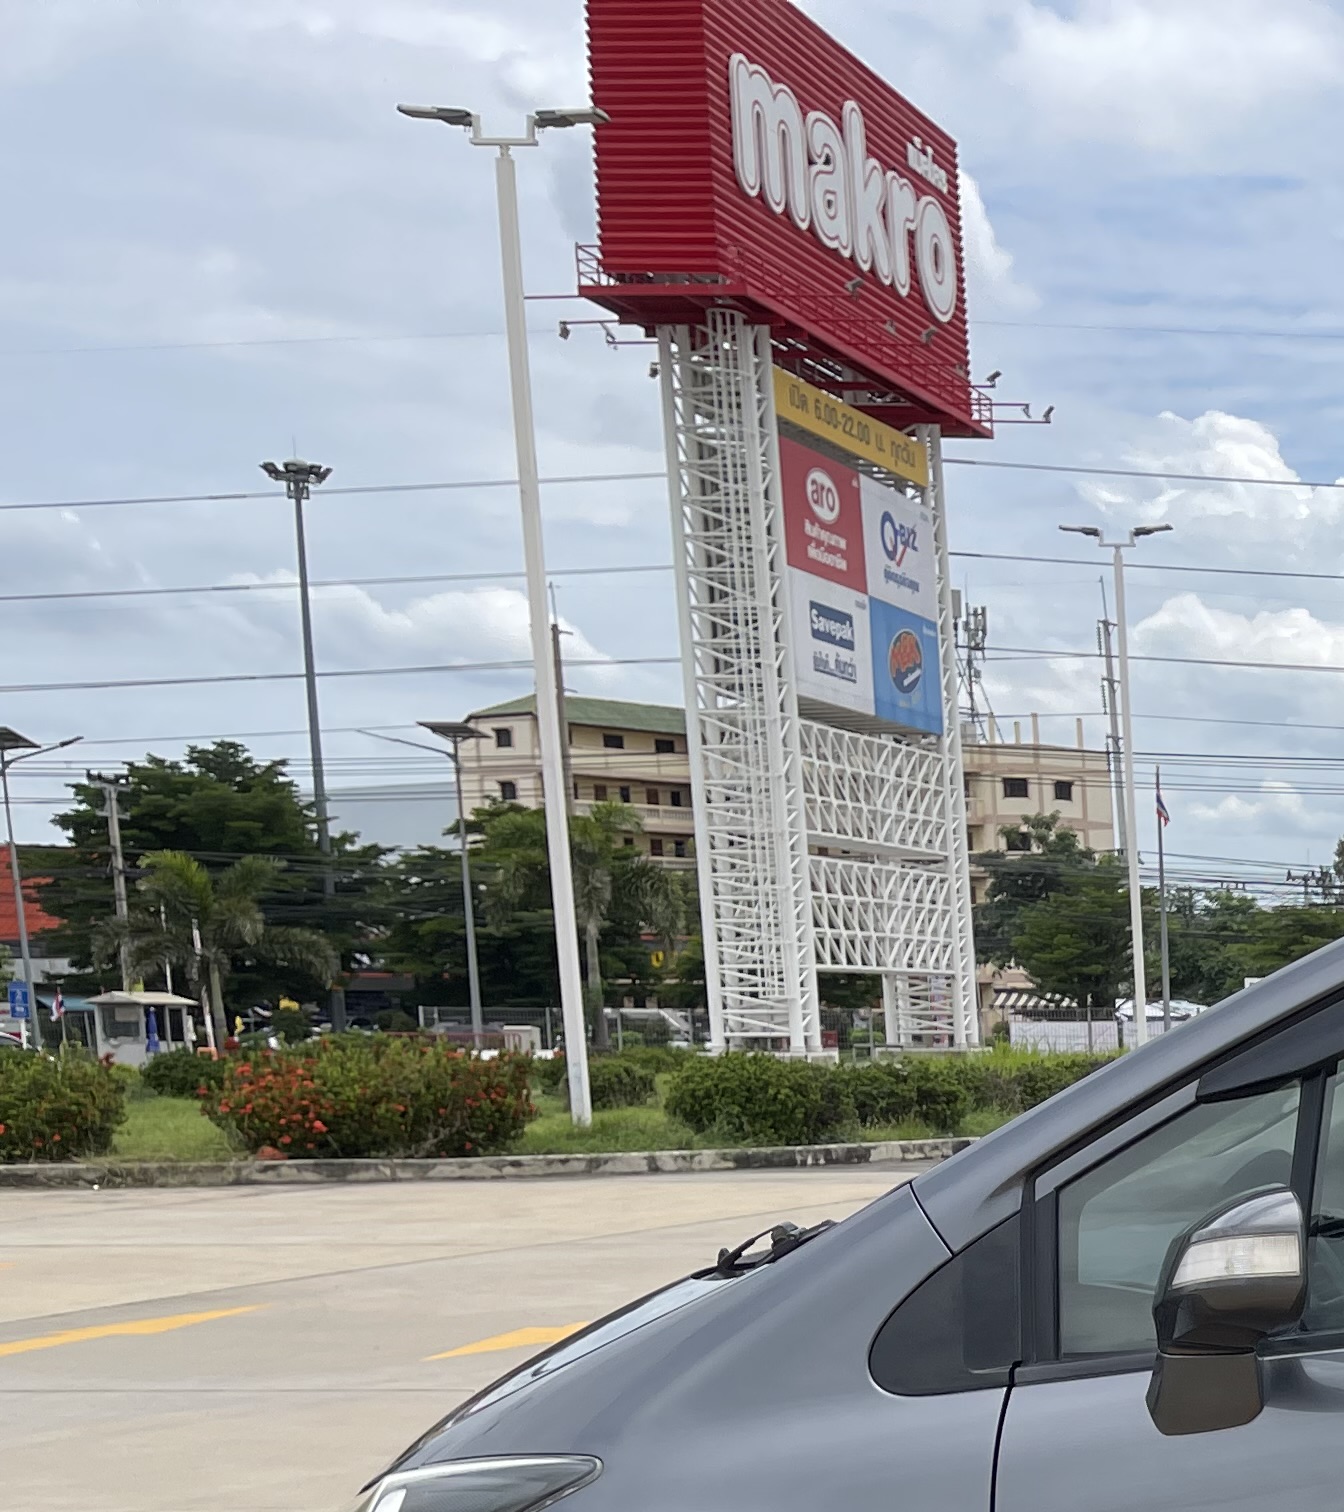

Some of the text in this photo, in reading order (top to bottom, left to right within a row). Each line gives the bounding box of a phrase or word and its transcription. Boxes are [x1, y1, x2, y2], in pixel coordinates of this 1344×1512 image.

[729, 53, 957, 323] makro
[788, 384, 809, 413] เปิด
[814, 398, 871, 446] 6.00-22.00
[810, 478, 836, 513] aro
[810, 608, 854, 641] Savepak
